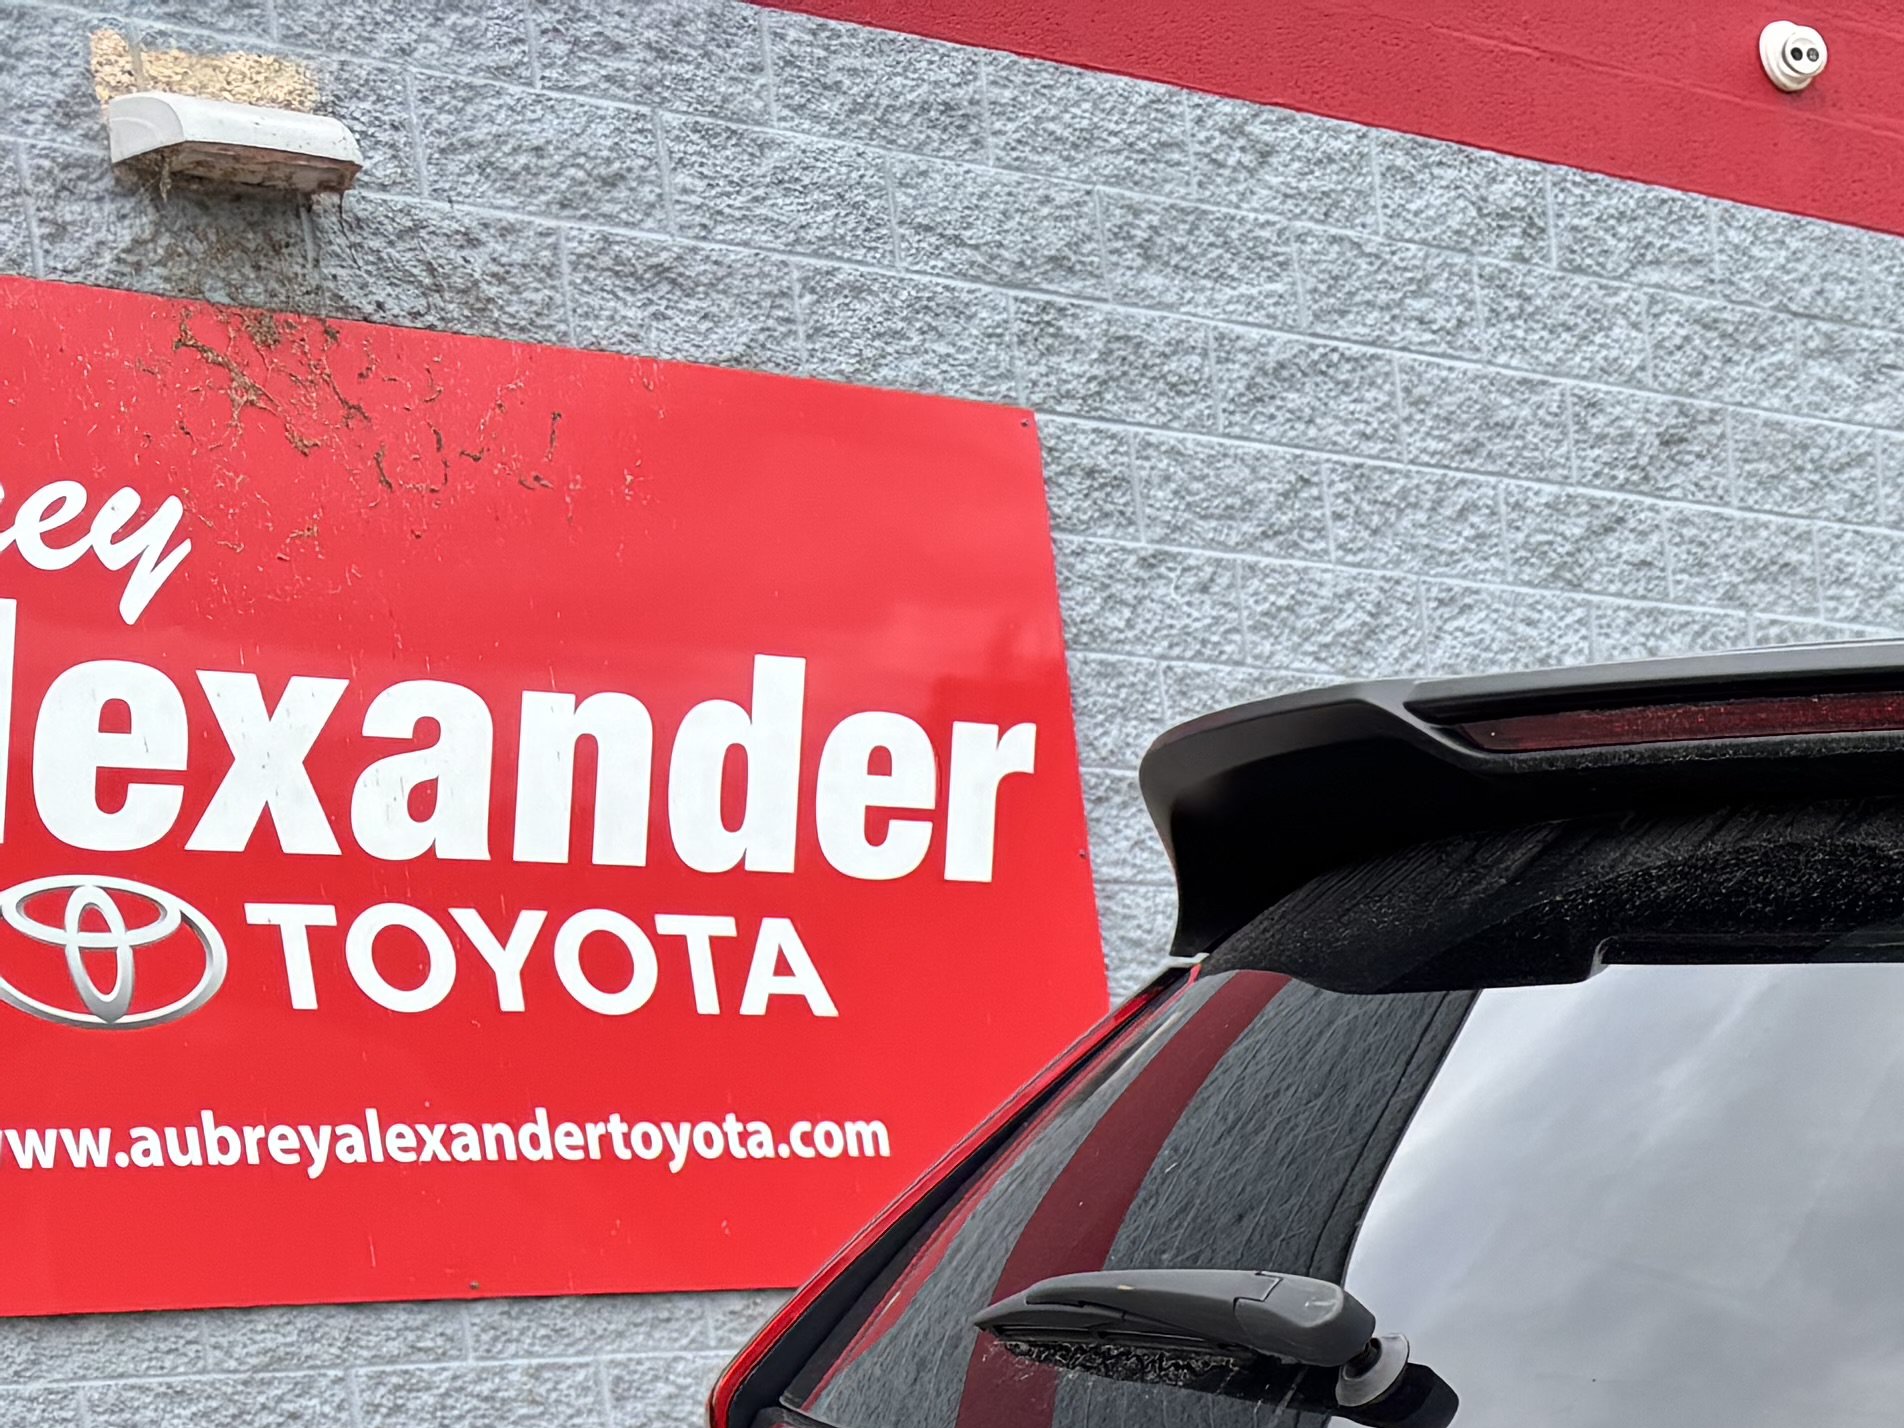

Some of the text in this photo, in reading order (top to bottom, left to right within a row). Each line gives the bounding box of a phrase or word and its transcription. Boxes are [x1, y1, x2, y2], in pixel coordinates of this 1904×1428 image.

[0, 480, 191, 626] ey
[244, 902, 839, 1017] TOYOTA
[0, 1107, 891, 1179] ww.aubreyalexandertoyota.com
